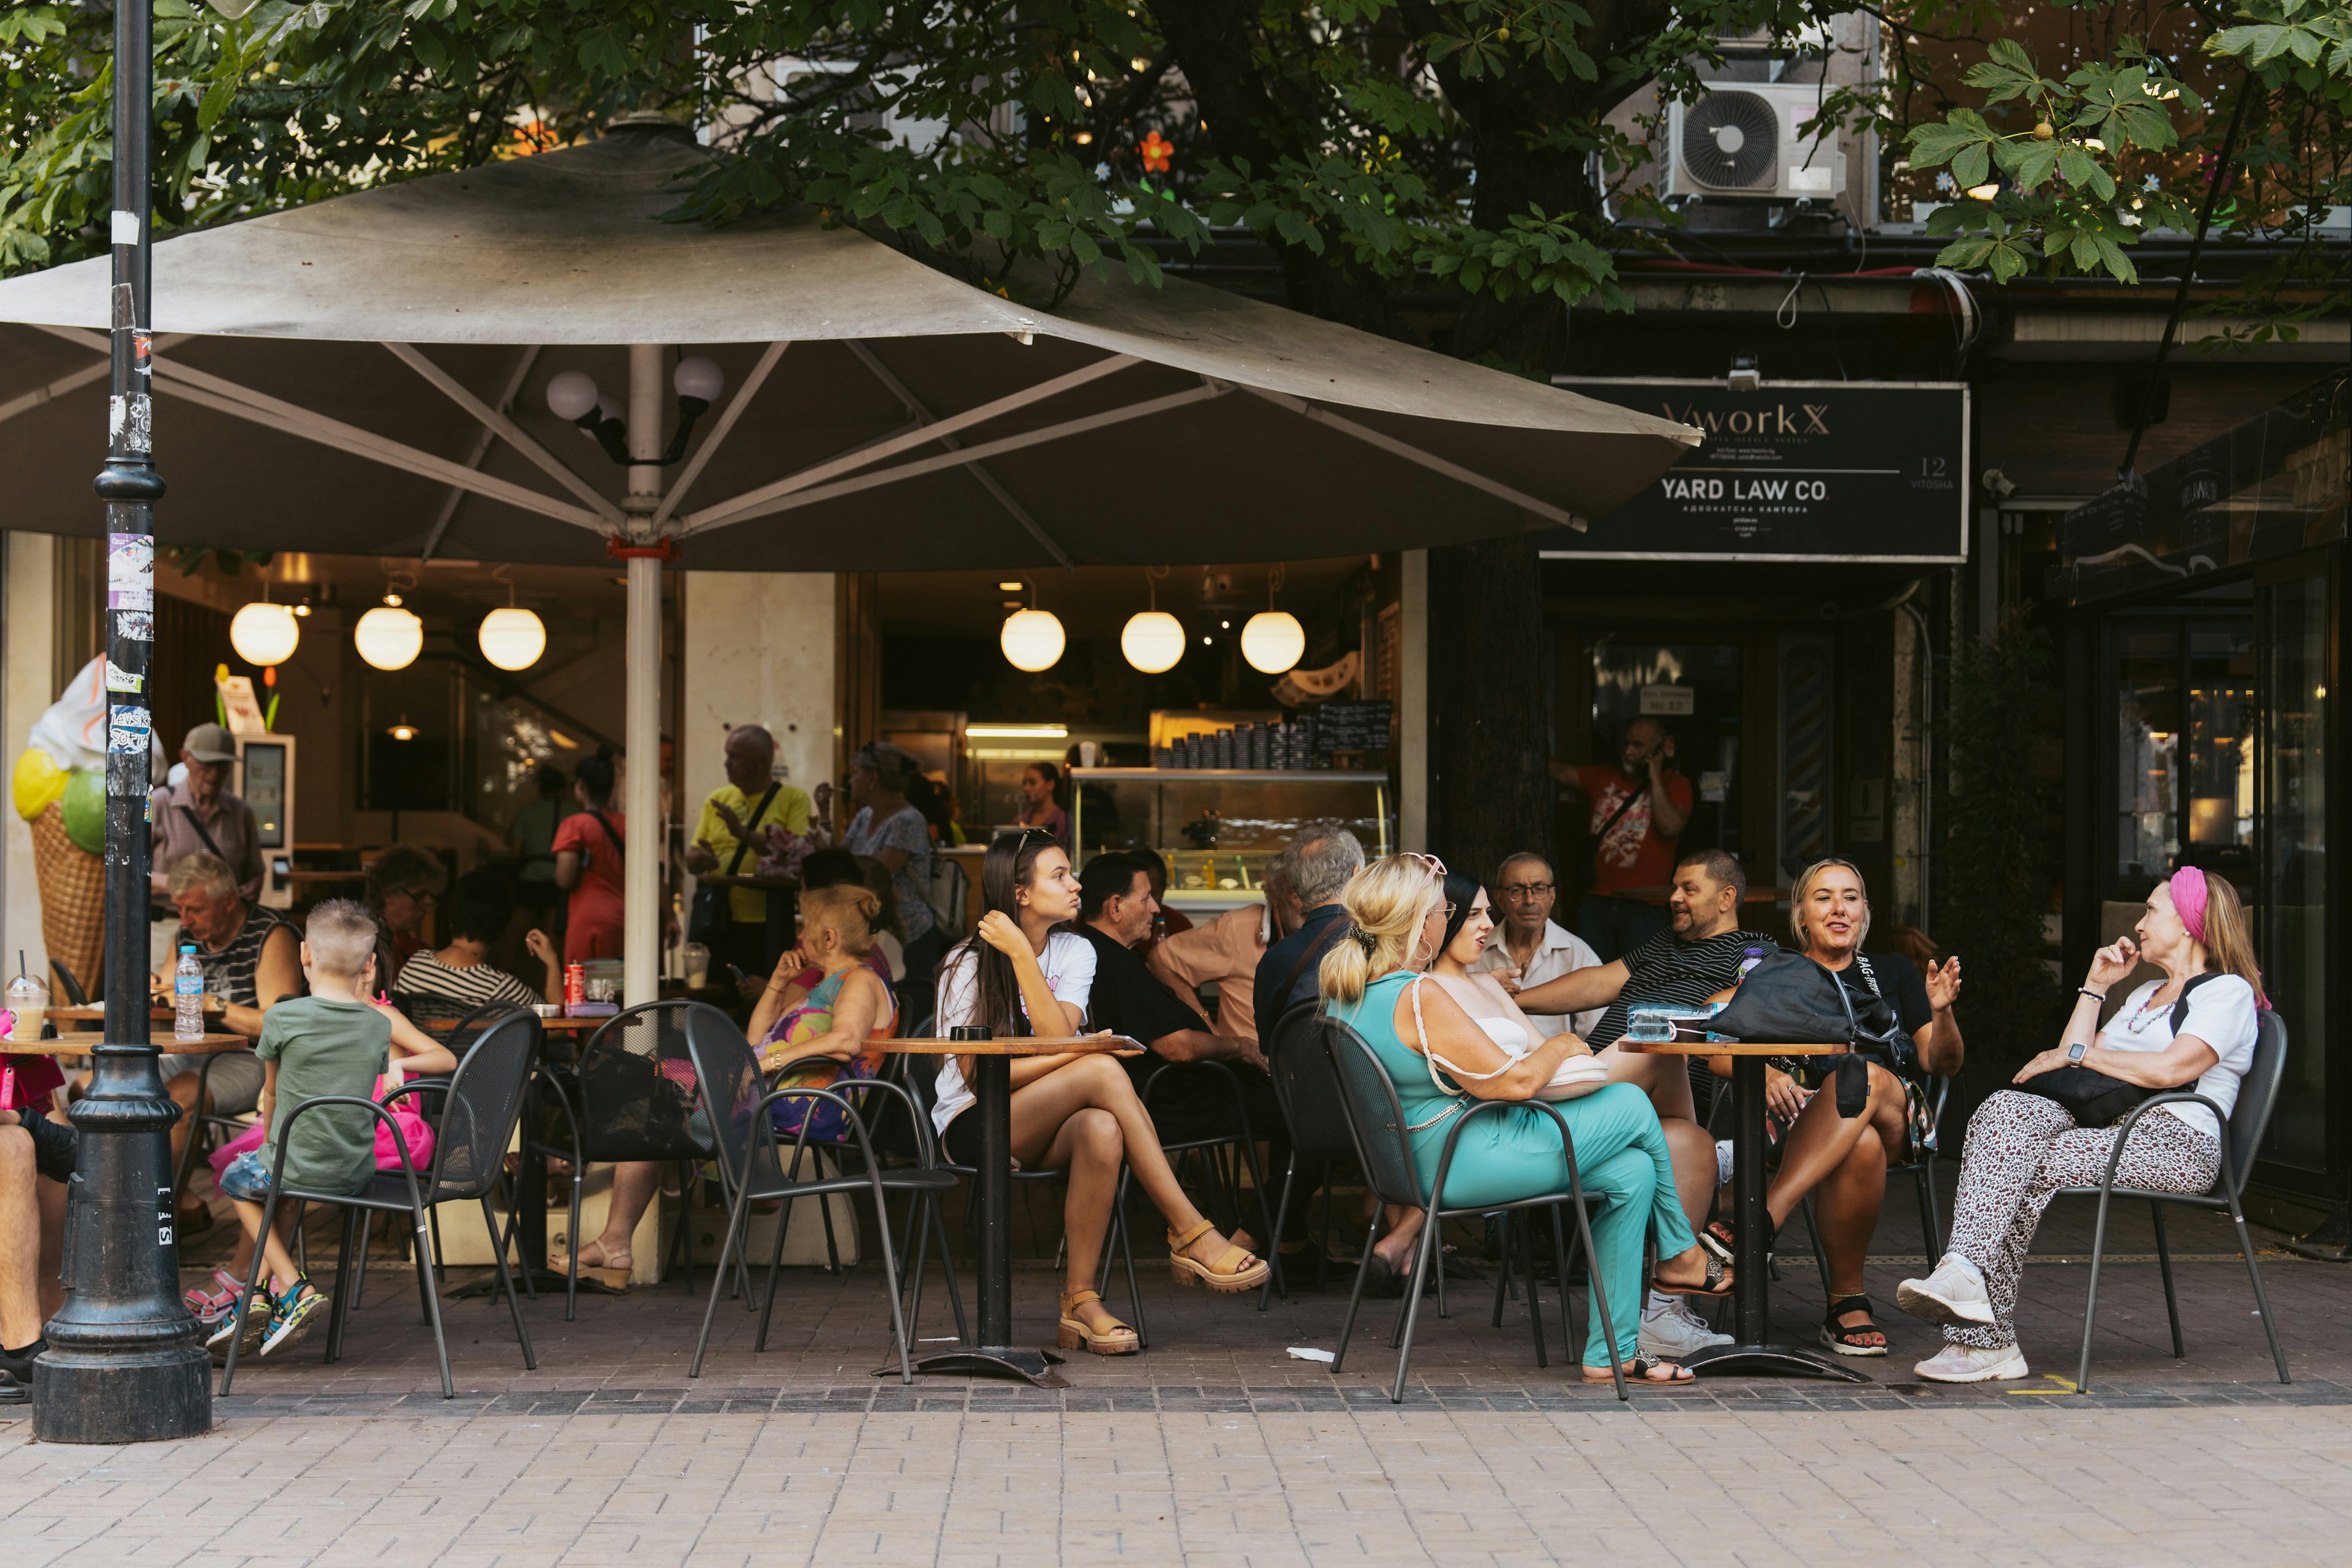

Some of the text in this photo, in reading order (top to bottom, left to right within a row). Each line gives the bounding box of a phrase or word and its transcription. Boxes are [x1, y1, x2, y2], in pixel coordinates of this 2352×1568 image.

[1918, 456, 1946, 477] 12
[1661, 478, 1724, 499] YARD
[1734, 479, 1789, 501] LAW
[1911, 480, 1953, 490] VITOSHA
